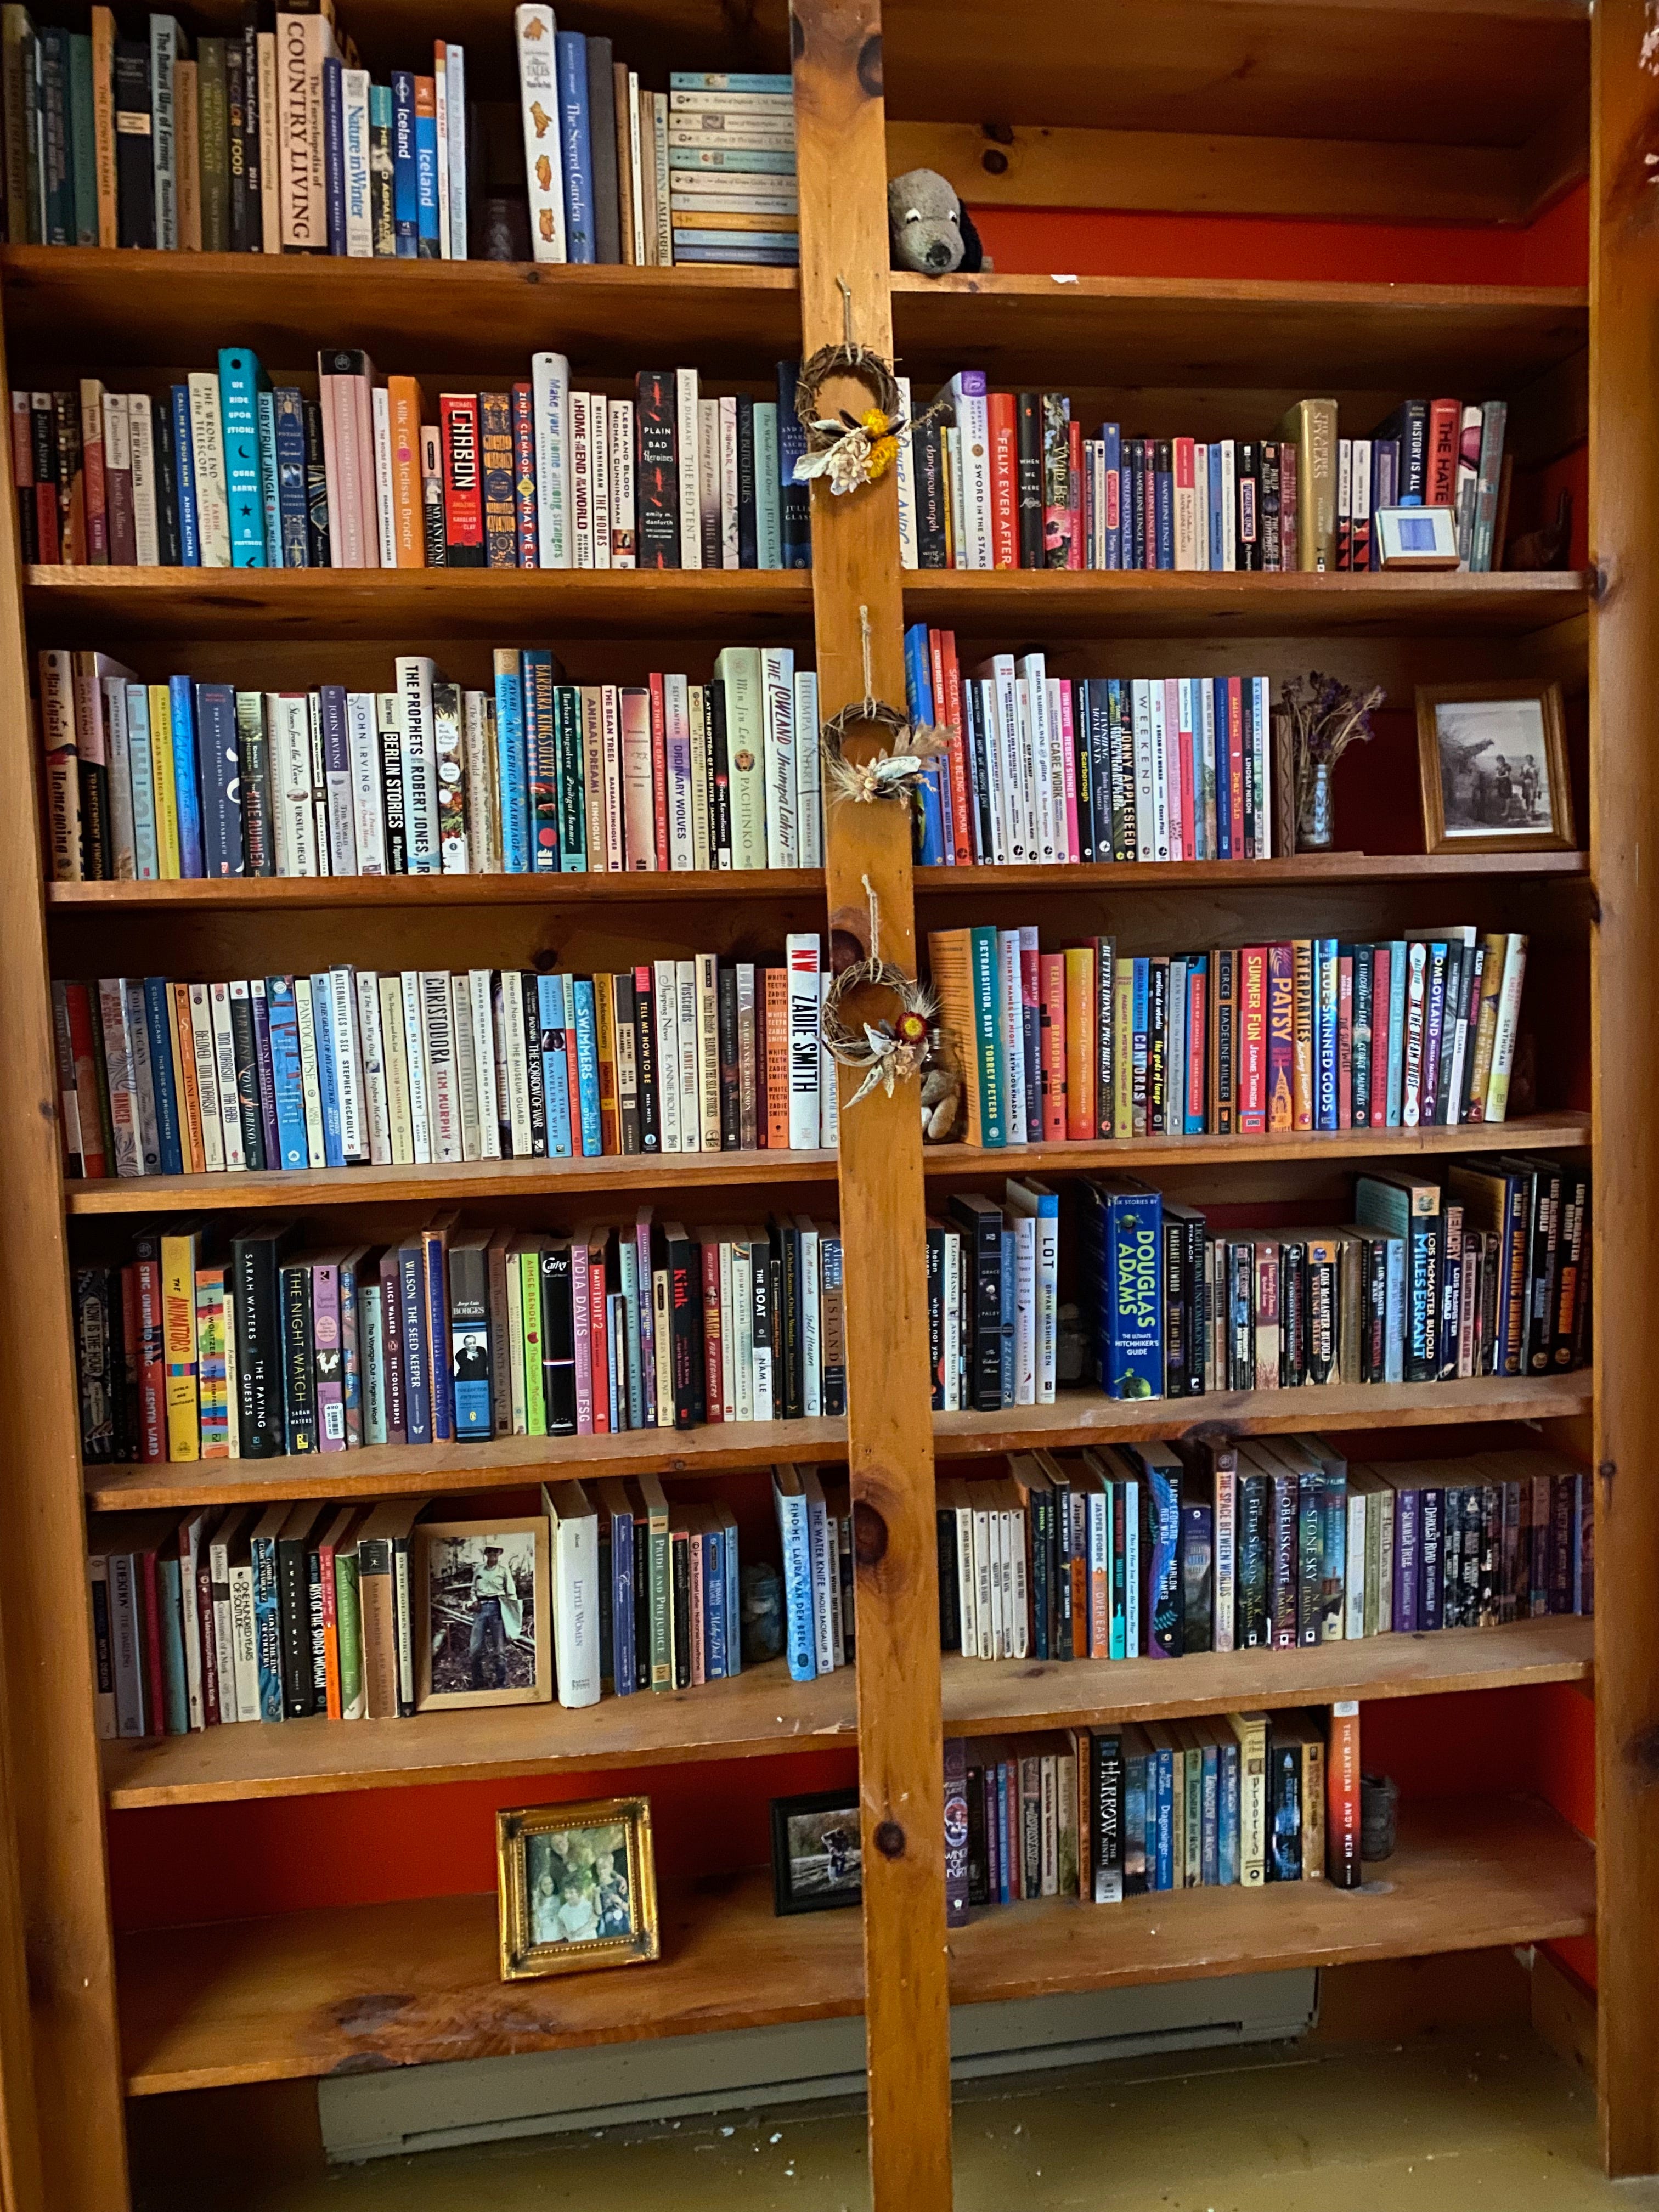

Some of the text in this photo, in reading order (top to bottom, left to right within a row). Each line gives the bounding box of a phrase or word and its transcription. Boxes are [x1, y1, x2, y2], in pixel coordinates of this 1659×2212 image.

[287, 22, 309, 238] COUNTRY LIVING
[308, 75, 322, 188] The Encyclopedia of
[398, 108, 410, 158] Iceland
[567, 103, 582, 127] The
[347, 105, 366, 219] Nature in Winter
[419, 149, 433, 206] Iceland
[568, 129, 581, 170] Secret
[571, 174, 584, 222] Garden
[179, 415, 185, 426] ME
[179, 429, 186, 438] BY
[259, 399, 275, 501] RUBYFRUIT JUNGLE
[452, 410, 476, 488] CHABON
[975, 464, 984, 503] SWORD
[1410, 421, 1421, 491] HISTORY IS ALL
[596, 495, 607, 546] THE HOURS
[684, 455, 696, 542] THE RED TENT
[997, 437, 1012, 564] FELIX EVER AFTER
[405, 665, 423, 755] THE PROPHETS
[605, 689, 613, 706] THE
[606, 709, 614, 734] BEAN
[384, 733, 403, 828] BERLIN STORIES
[768, 659, 794, 850] THE LOWLAND Jhumpa Lahiri
[1051, 742, 1063, 798] CARE WORK
[1080, 751, 1090, 802] Scarborough
[1121, 727, 1136, 846] JONNY APPLESEED
[52, 770, 71, 853] Homegoing
[411, 766, 426, 811] ROBERT
[674, 745, 686, 839] ORDINARY WOLVES
[740, 777, 753, 849] PACHINKO
[413, 817, 428, 856] JONES,
[740, 970, 752, 1012] LILA
[792, 950, 818, 973] NW
[980, 940, 993, 1038] DETRANSITION, BABY
[1221, 966, 1229, 997] CIRCE
[1429, 951, 1445, 1036] TOMBOYLAND
[335, 974, 347, 1026] ALTERNATIVES
[425, 978, 450, 1064] CHRISTODORA
[640, 1002, 648, 1018] TELL
[641, 1022, 649, 1034] ME
[1247, 956, 1261, 1040] SUMMER FUN
[1272, 978, 1292, 1041] PATSY
[1296, 947, 1311, 1043] AFTERPARTIES
[340, 1039, 349, 1053] SEX
[578, 1009, 592, 1080] SWIMMERS
[643, 1060, 650, 1071] TO
[792, 995, 818, 1093] ZADIE SMITH
[1221, 1007, 1229, 1060] MADELINE
[1322, 962, 1334, 1112] BLUE-SKINNED GODS
[342, 1060, 354, 1139] STEPHEN McCAULEY
[437, 1070, 450, 1140] TIM MURPHY
[644, 1074, 651, 1084] BE
[985, 1045, 997, 1119] TORREY PETERS
[1249, 1044, 1259, 1108] JEANNE THORNTON
[1043, 1238, 1054, 1269] LOT
[1118, 1243, 1137, 1315] ADAMS
[1137, 1231, 1155, 1328] DOUGLAS
[245, 1254, 256, 1340] SARAH WATERS
[574, 1250, 588, 1336] LYDIA DAVIS
[674, 1269, 688, 1310] Kink
[756, 1288, 766, 1317] BOAT
[1413, 1234, 1428, 1359] MILES ERRANT
[1426, 1232, 1436, 1359] LOIS McMASTER BUJOLD
[289, 1272, 306, 1401] THE NIGHT WATCH
[243, 1374, 252, 1416] GUESTS
[255, 1361, 266, 1428] THE PAYING
[579, 1399, 590, 1422] FSG
[759, 1384, 766, 1392] LE
[655, 1539, 665, 1571] PRIDE
[815, 1529, 824, 1558] WATER
[1220, 1475, 1232, 1597] THE SPACE BETWEEN WORLDS
[1306, 1510, 1317, 1581] STONE SKY
[816, 1561, 825, 1586] KNIFE
[309, 1584, 326, 1688] KISS OF THE SPIDER WOMAN
[574, 1580, 585, 1646] LITTLE WOMEN
[655, 1596, 666, 1654] PREJUDICE
[1101, 1760, 1121, 1837] HARROW
[1159, 1805, 1169, 1857] Dragonsinger:
